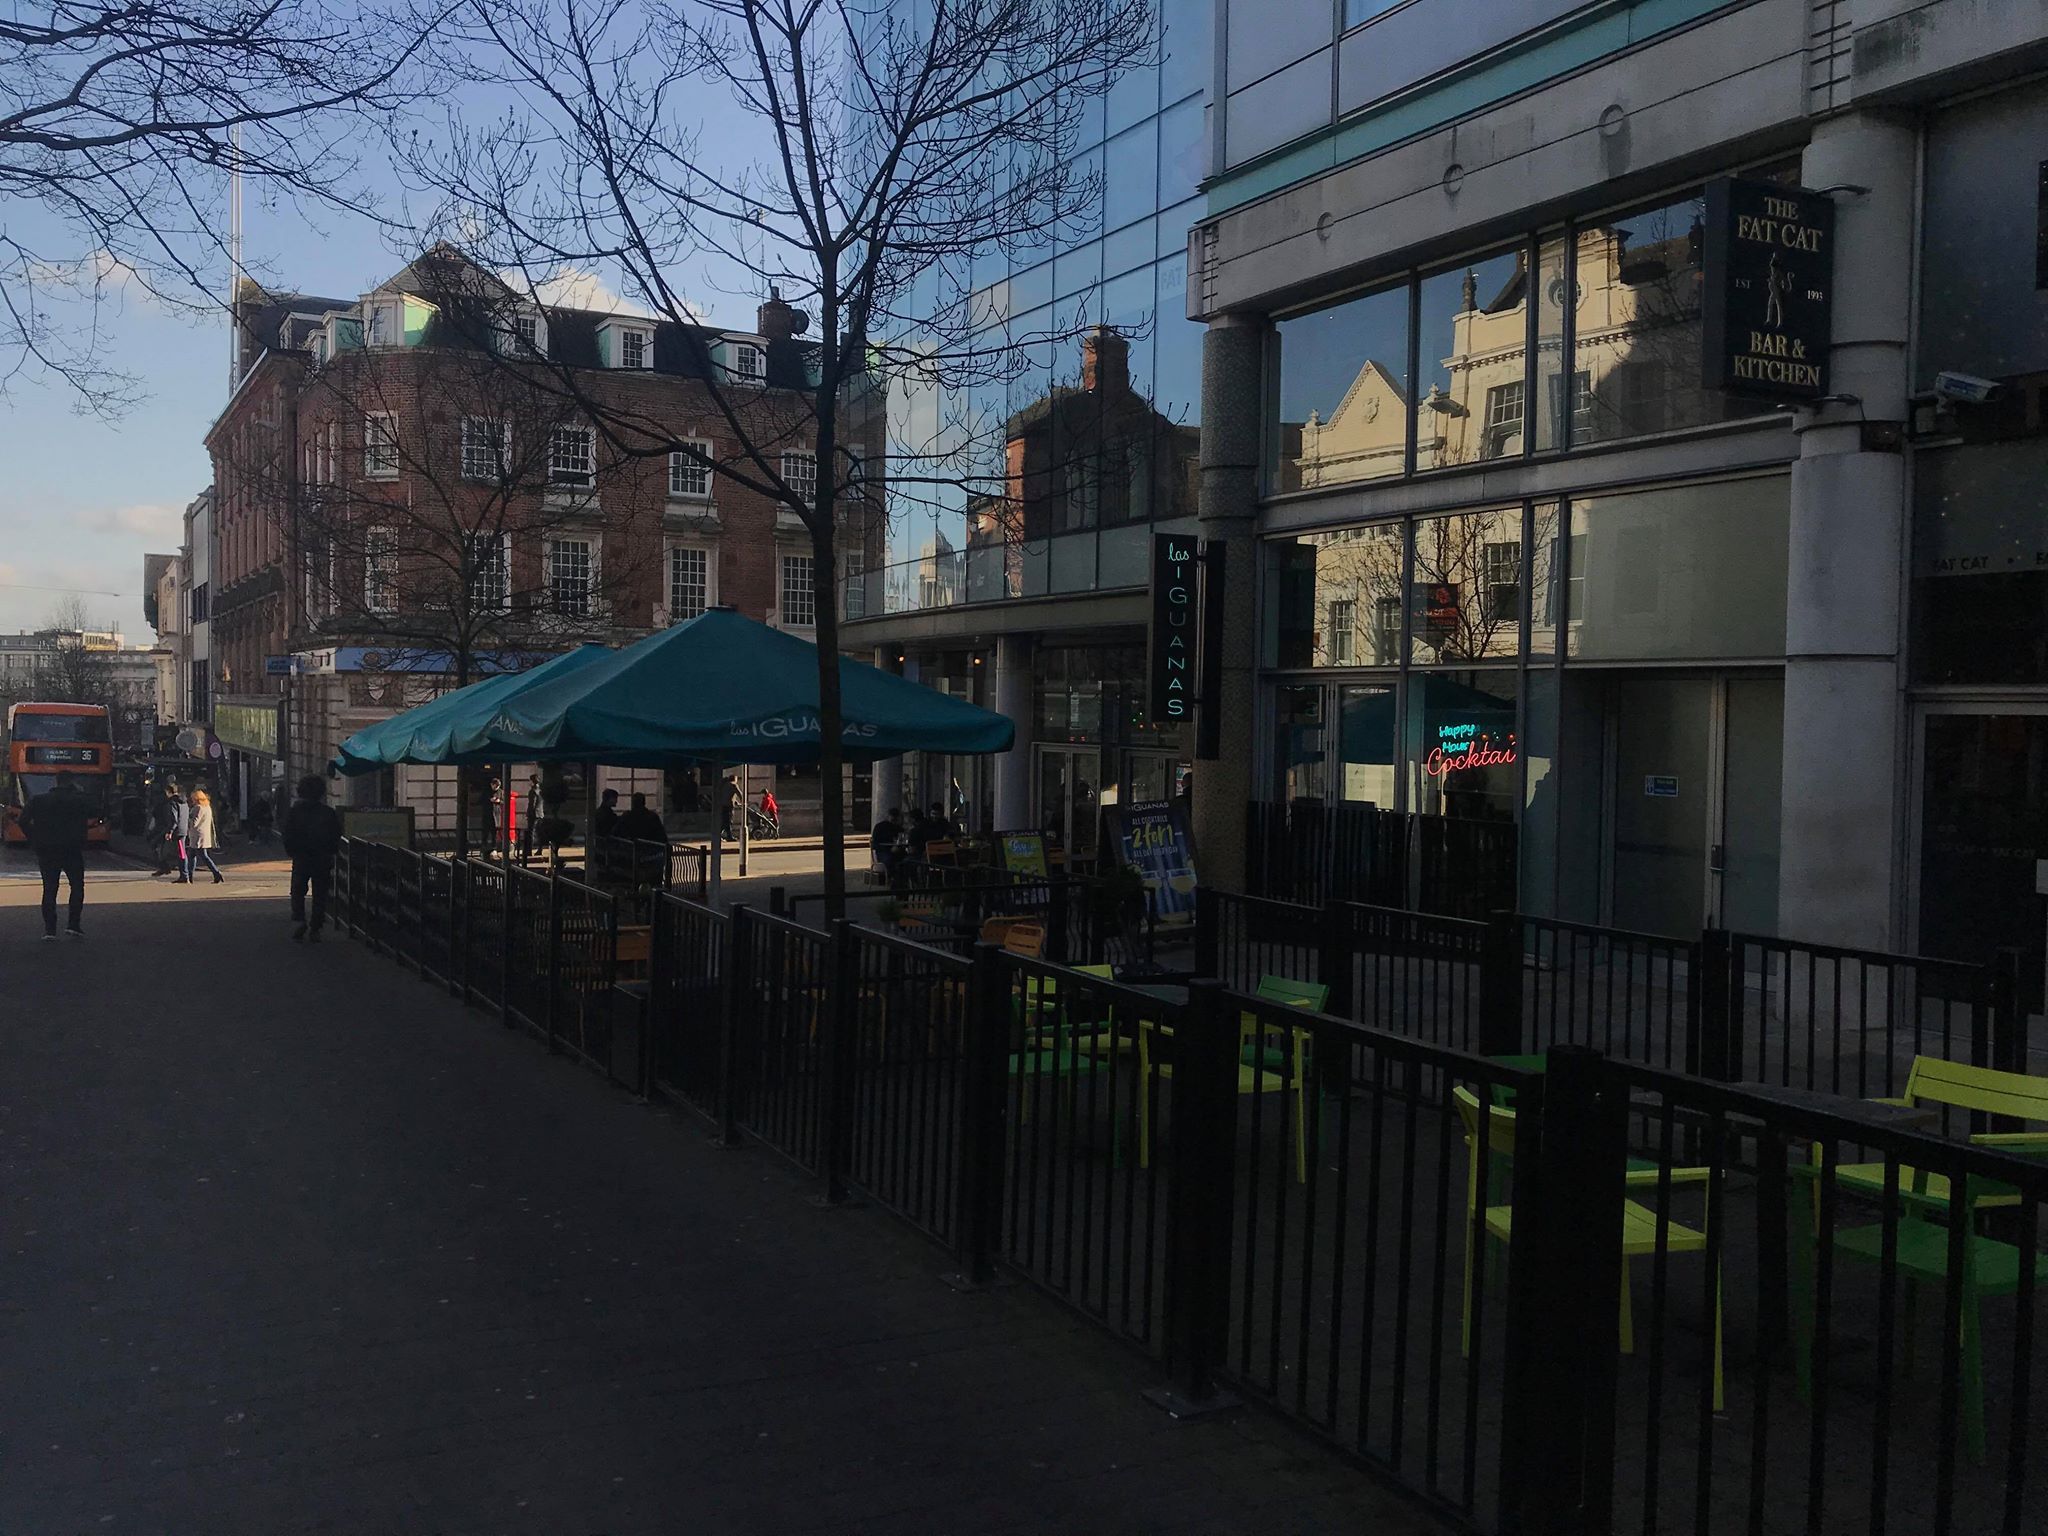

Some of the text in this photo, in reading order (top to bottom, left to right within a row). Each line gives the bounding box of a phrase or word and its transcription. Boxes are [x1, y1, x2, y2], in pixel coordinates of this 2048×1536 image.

[1764, 196, 1799, 220] THE
[1738, 214, 1823, 252] FAT CAT
[1735, 278, 1823, 301] EST 1993
[1750, 331, 1806, 360] BAR &
[1734, 354, 1821, 387] KITCHEN
[1168, 542, 1190, 562] las
[1961, 555, 1989, 570] CAT
[1167, 565, 1188, 715] IGUANAS
[730, 715, 879, 737] las IGUAAS
[1439, 723, 1476, 740] Happy
[1442, 741, 1471, 753] Hour
